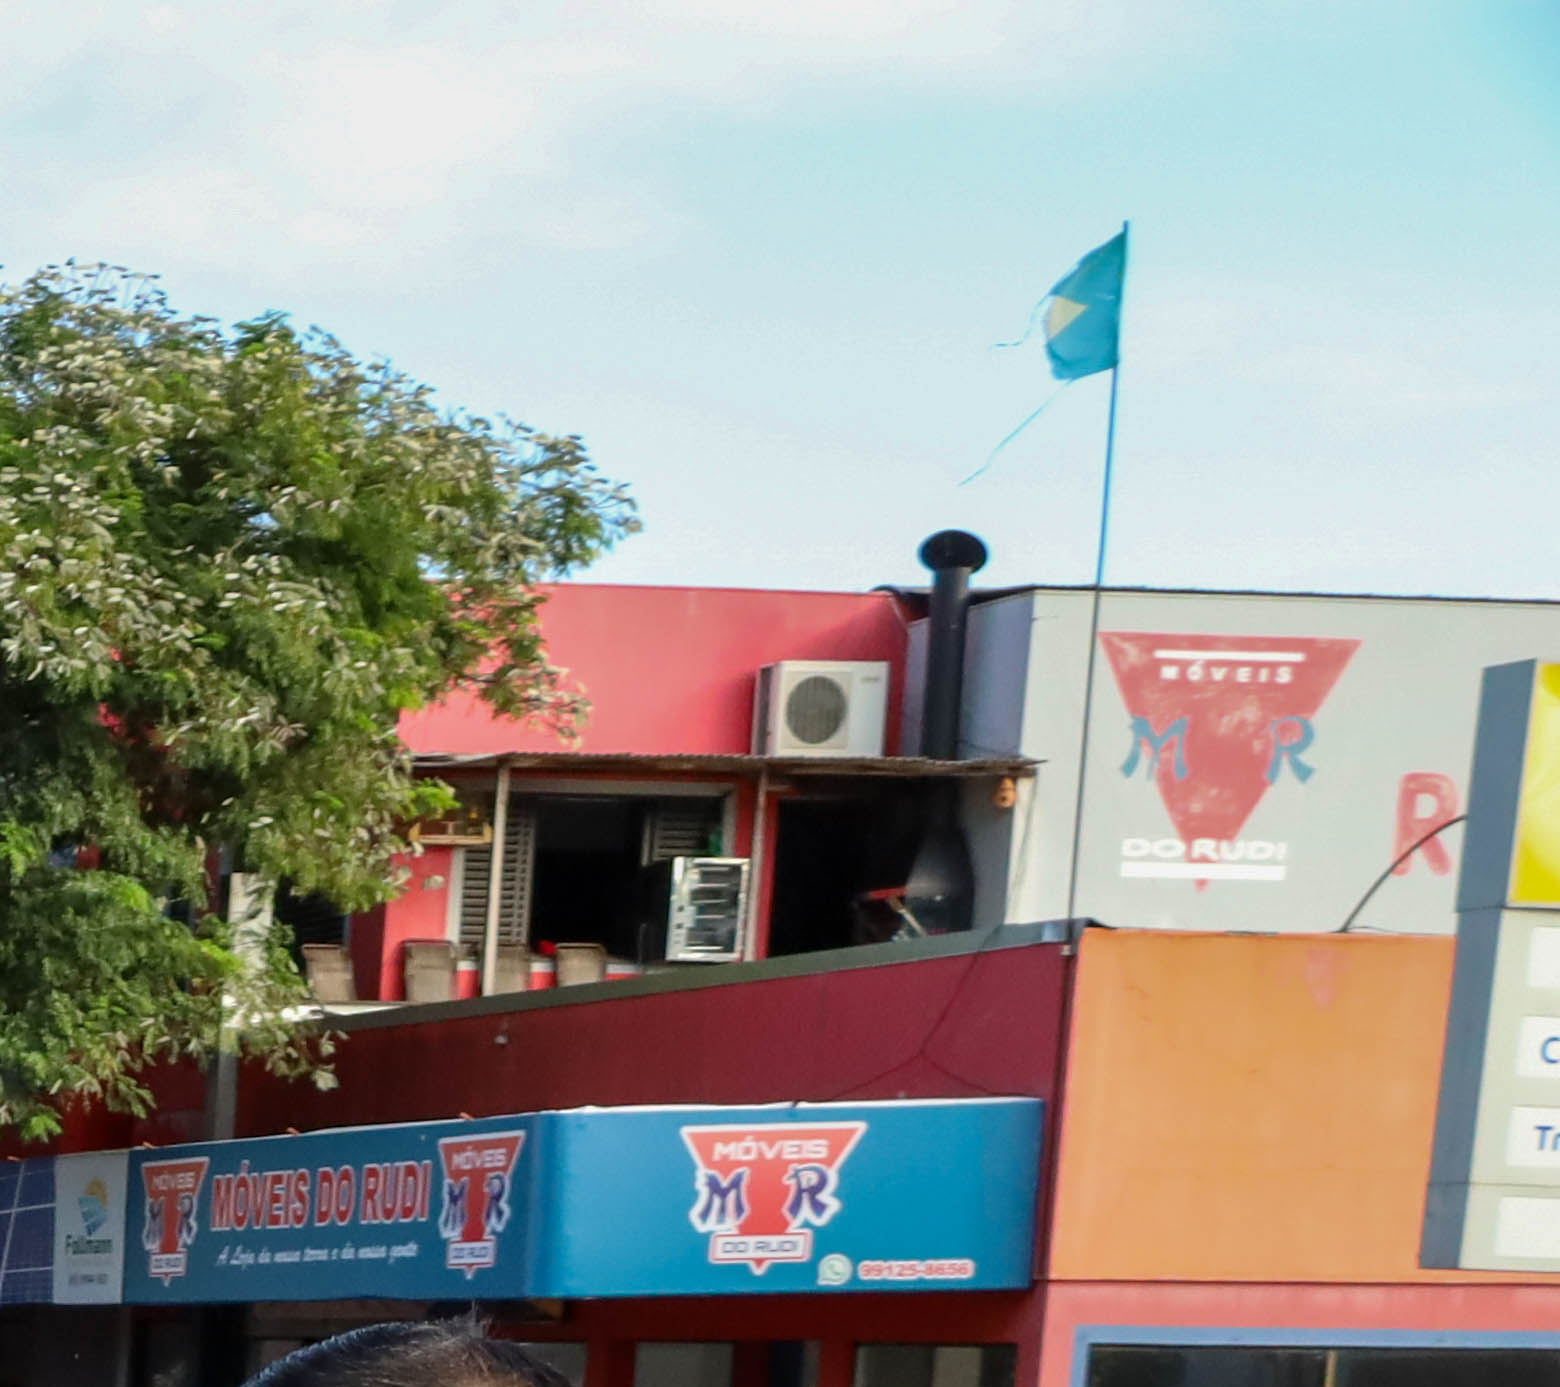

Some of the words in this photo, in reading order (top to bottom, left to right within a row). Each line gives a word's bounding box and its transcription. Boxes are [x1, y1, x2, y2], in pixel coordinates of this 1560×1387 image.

[1160, 660, 1294, 684] MÓVEIS
[1121, 838, 1185, 860] DO
[1191, 838, 1289, 861] RUDI
[451, 1145, 508, 1170] MÓVEIS
[712, 1136, 830, 1161] MÓVEIS
[152, 1170, 196, 1191] MÓVEIS
[210, 1159, 311, 1232] MÓVEIS
[314, 1165, 356, 1228] DO
[361, 1160, 432, 1225] RUDI
[722, 1241, 750, 1253] DO
[754, 1239, 800, 1253] RUDI
